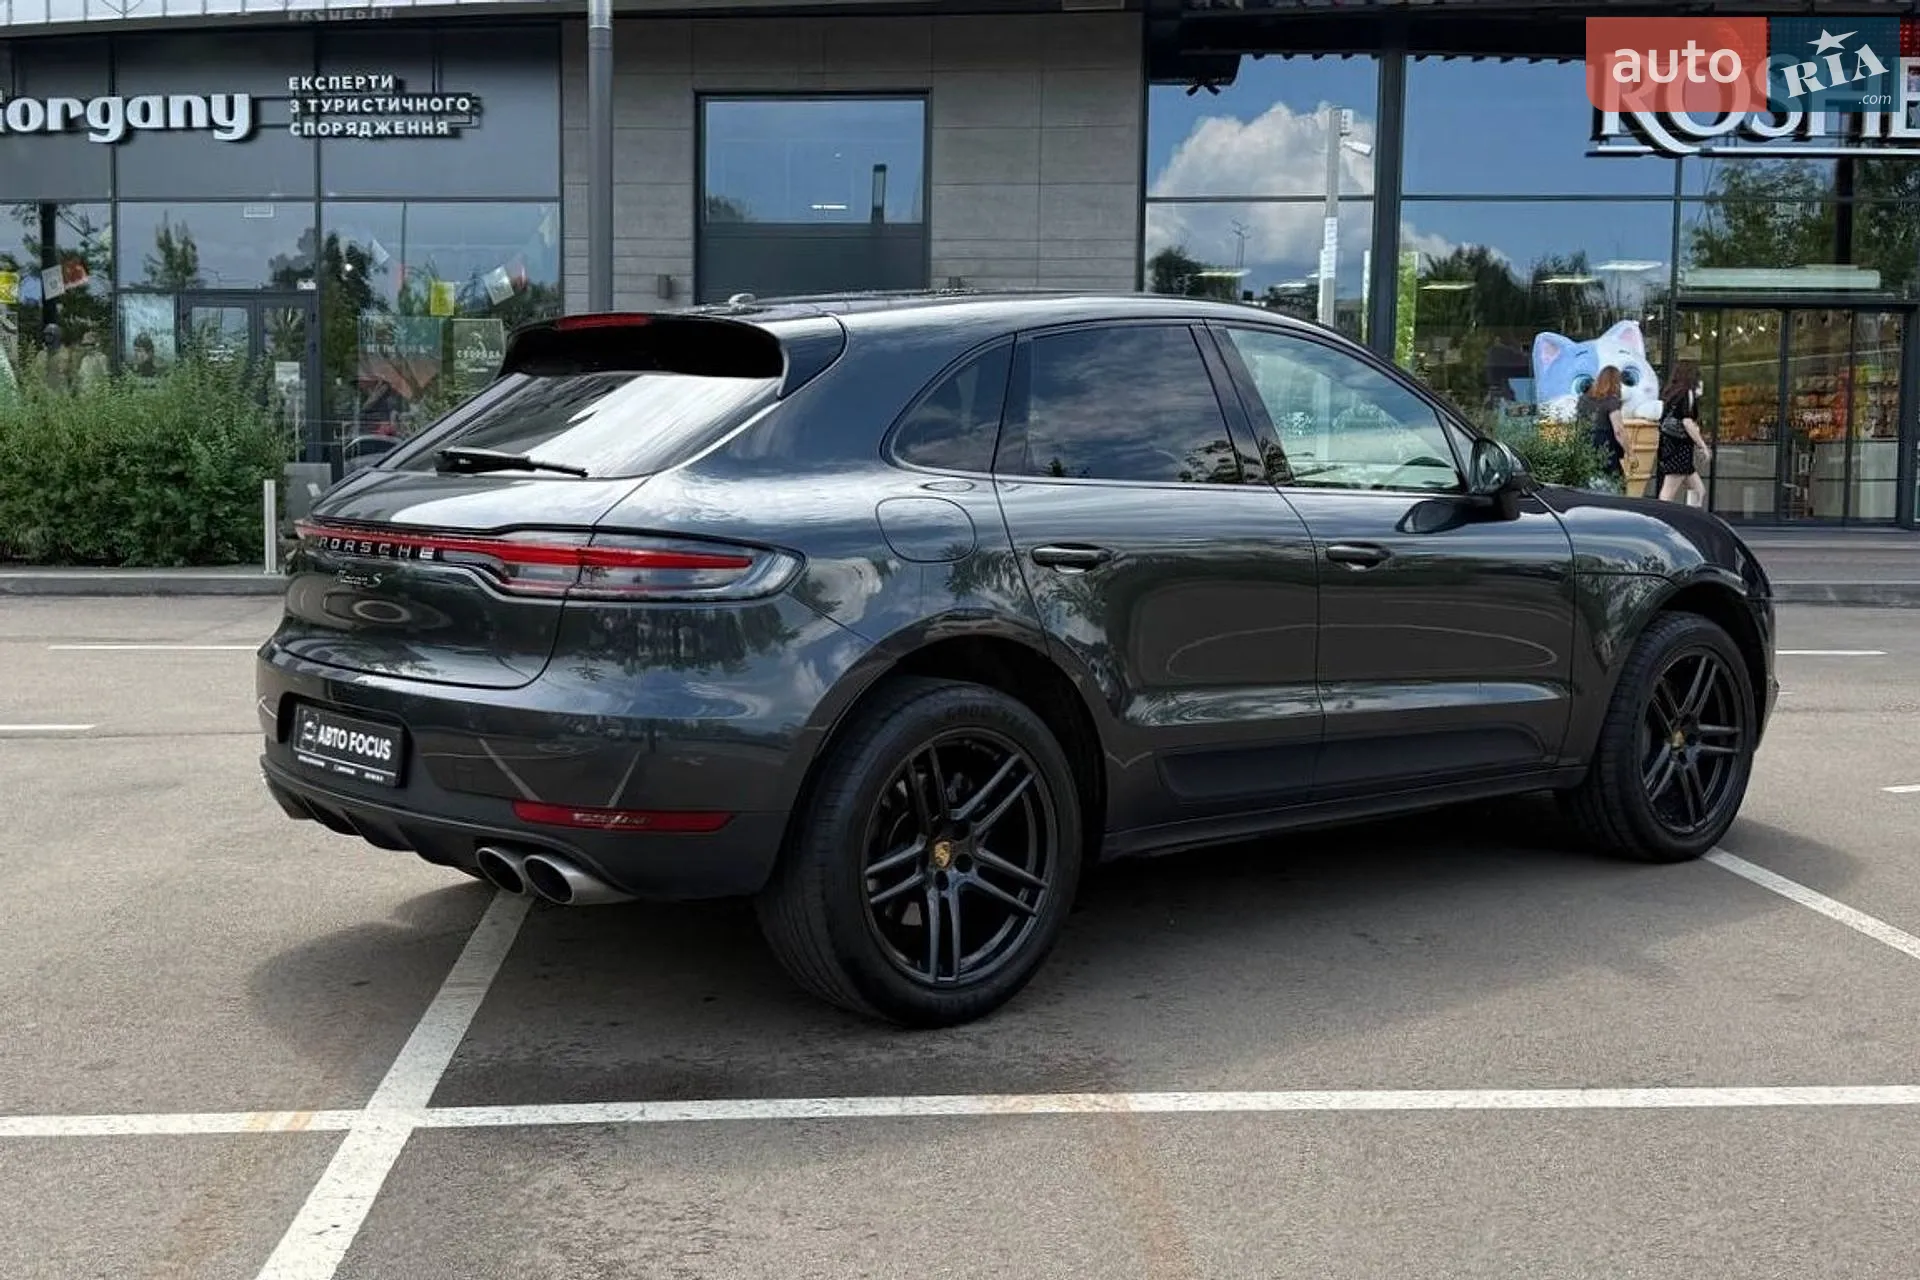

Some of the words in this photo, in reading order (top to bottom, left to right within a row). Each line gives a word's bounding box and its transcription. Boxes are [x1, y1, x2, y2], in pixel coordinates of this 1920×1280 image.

[288, 74, 394, 91] ЕКСПЕРТИ
[307, 97, 471, 114] ТУРИСТИЧНОГО
[0, 90, 250, 143] organy
[289, 121, 449, 138] СПОРЯДЖЕННЯ
[317, 535, 435, 561] PORSCHE
[347, 731, 393, 761] FOCUS
